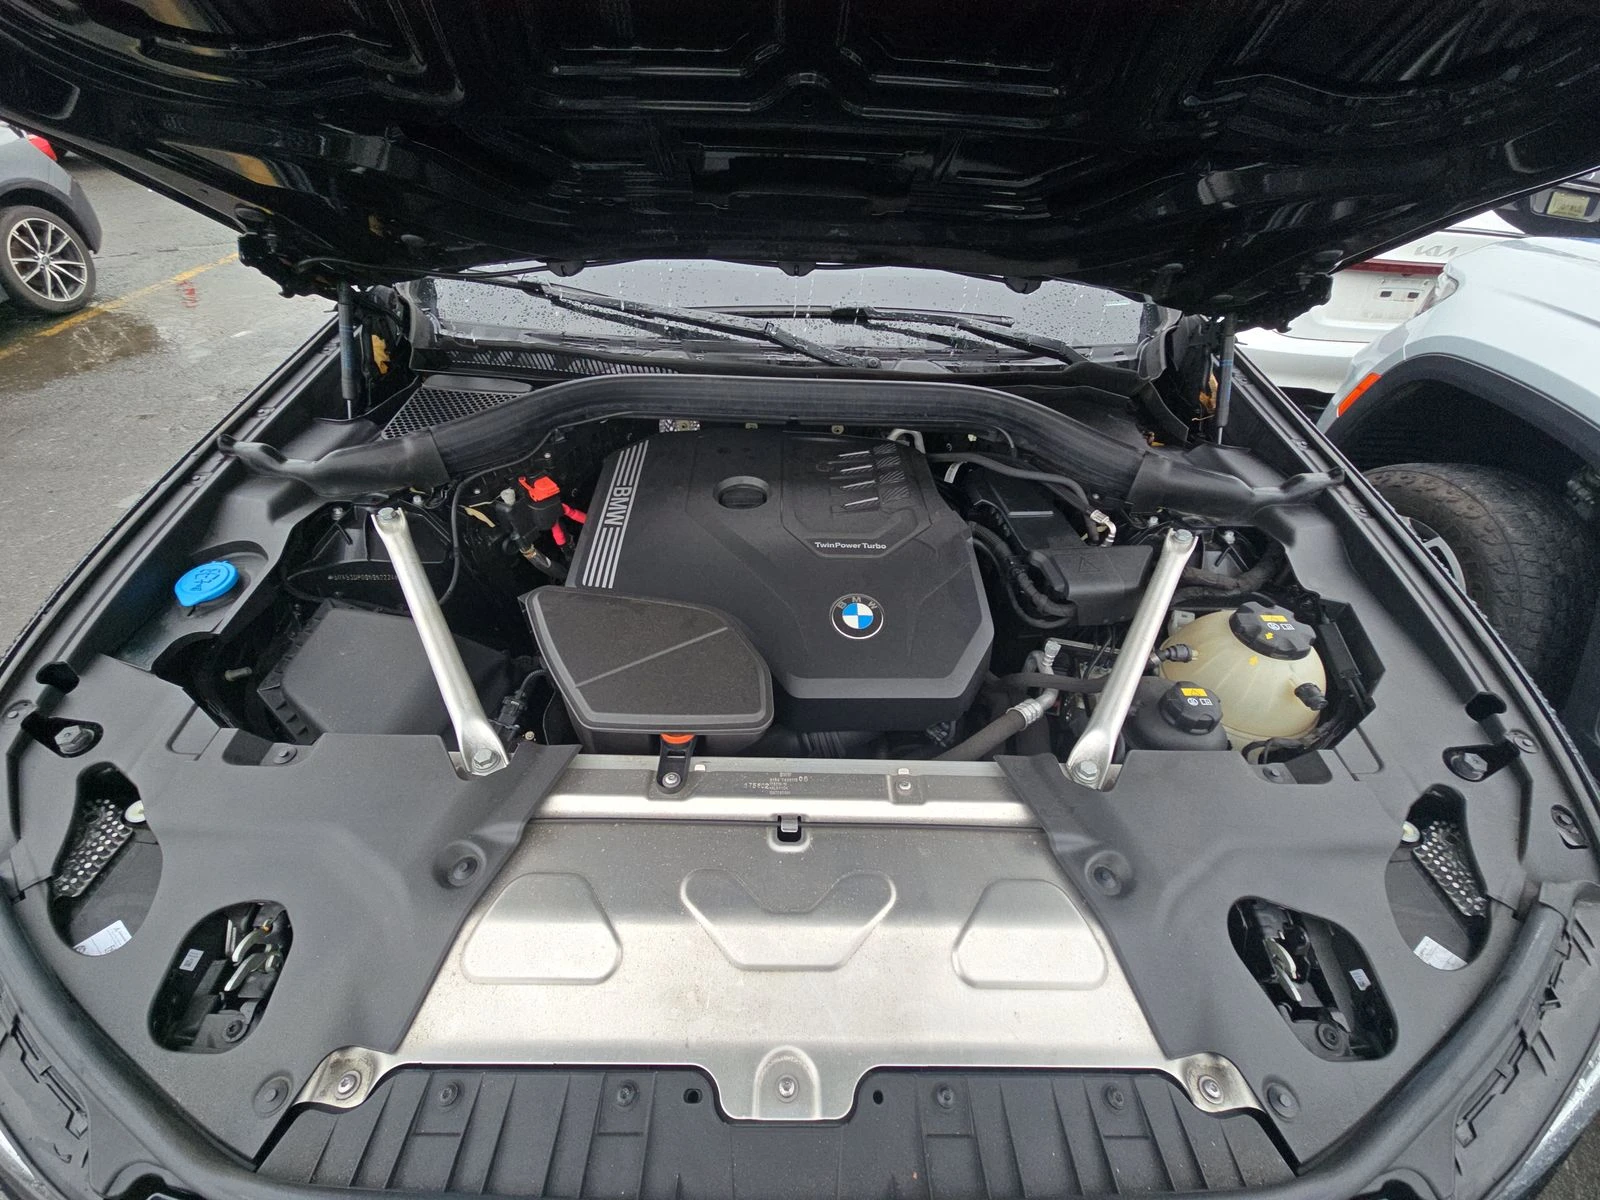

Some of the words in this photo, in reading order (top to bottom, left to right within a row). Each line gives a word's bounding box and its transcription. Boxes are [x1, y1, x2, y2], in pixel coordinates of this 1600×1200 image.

[604, 486, 633, 526] BMW
[814, 541, 862, 549] TwinPower
[835, 595, 878, 610] BMW
